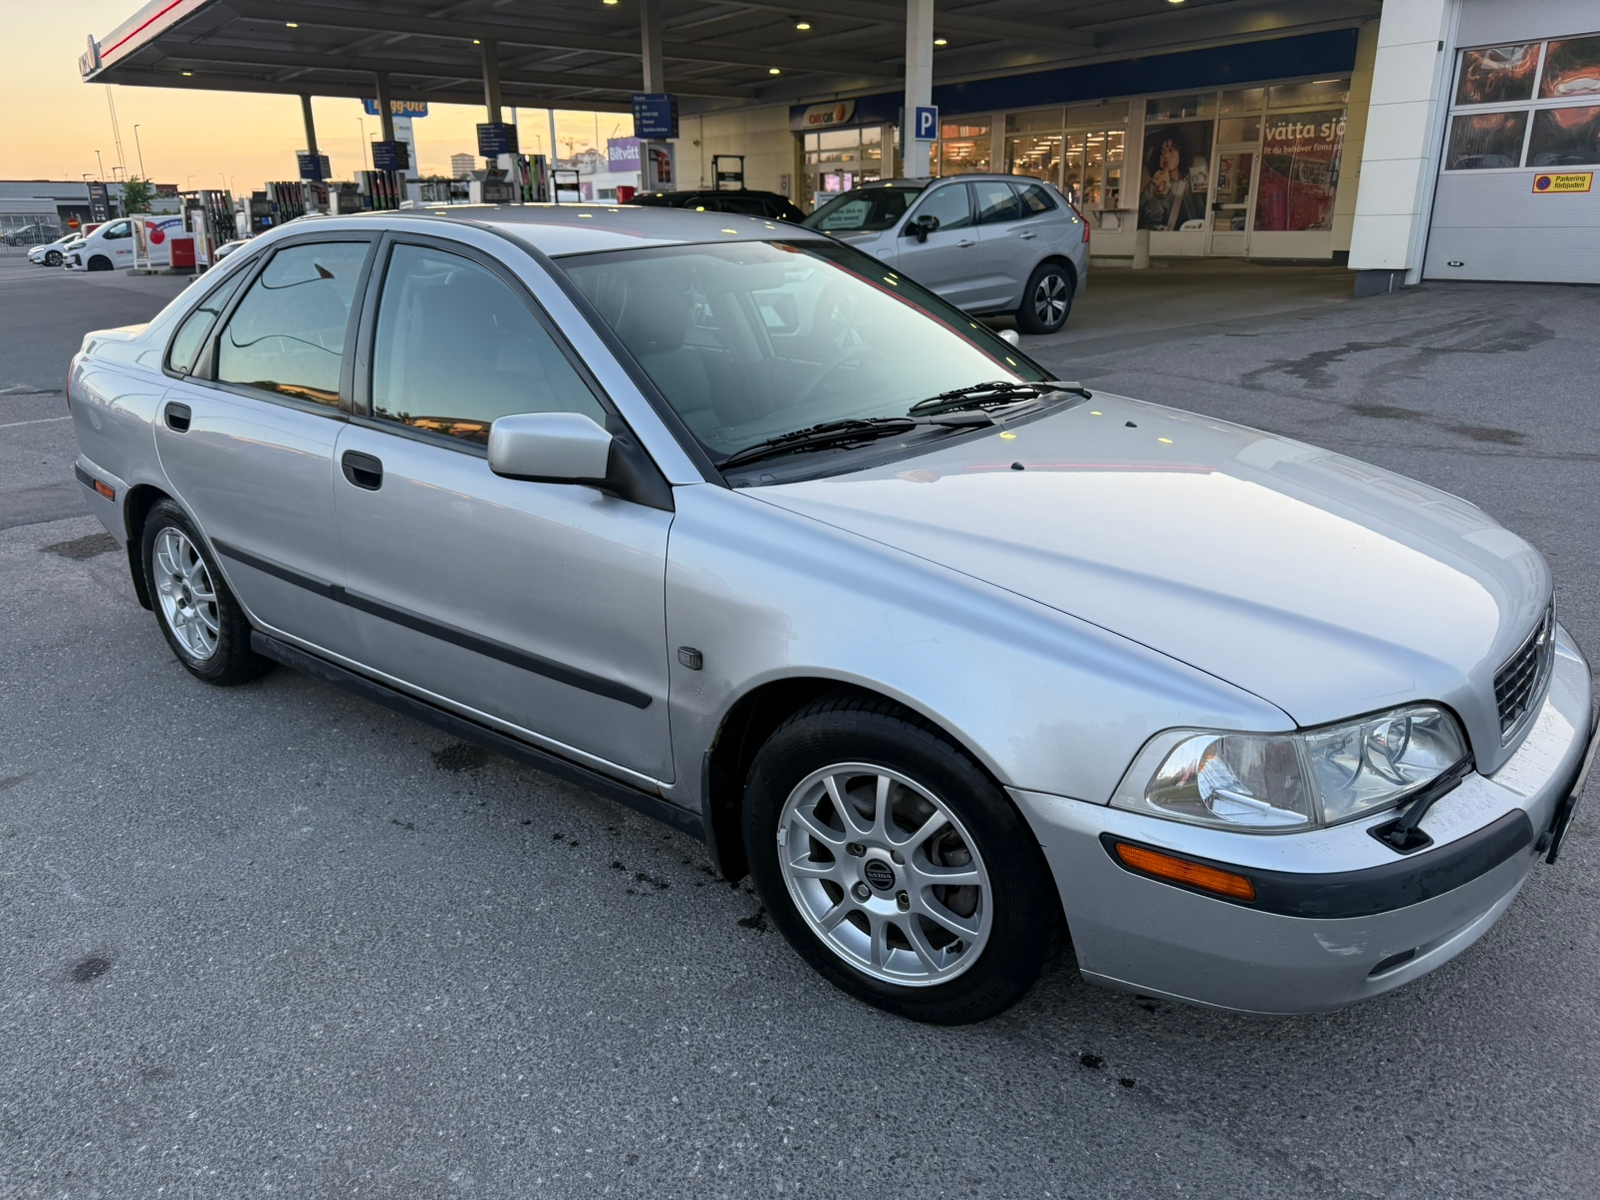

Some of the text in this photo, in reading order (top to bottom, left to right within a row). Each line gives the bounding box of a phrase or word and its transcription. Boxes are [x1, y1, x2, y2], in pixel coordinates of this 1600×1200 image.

[921, 112, 932, 135] P
[1255, 122, 1315, 141] vätta
[609, 145, 639, 161] Biltvätt
[1272, 146, 1282, 154] du
[1283, 144, 1312, 154] behöver
[1313, 142, 1332, 152] finns
